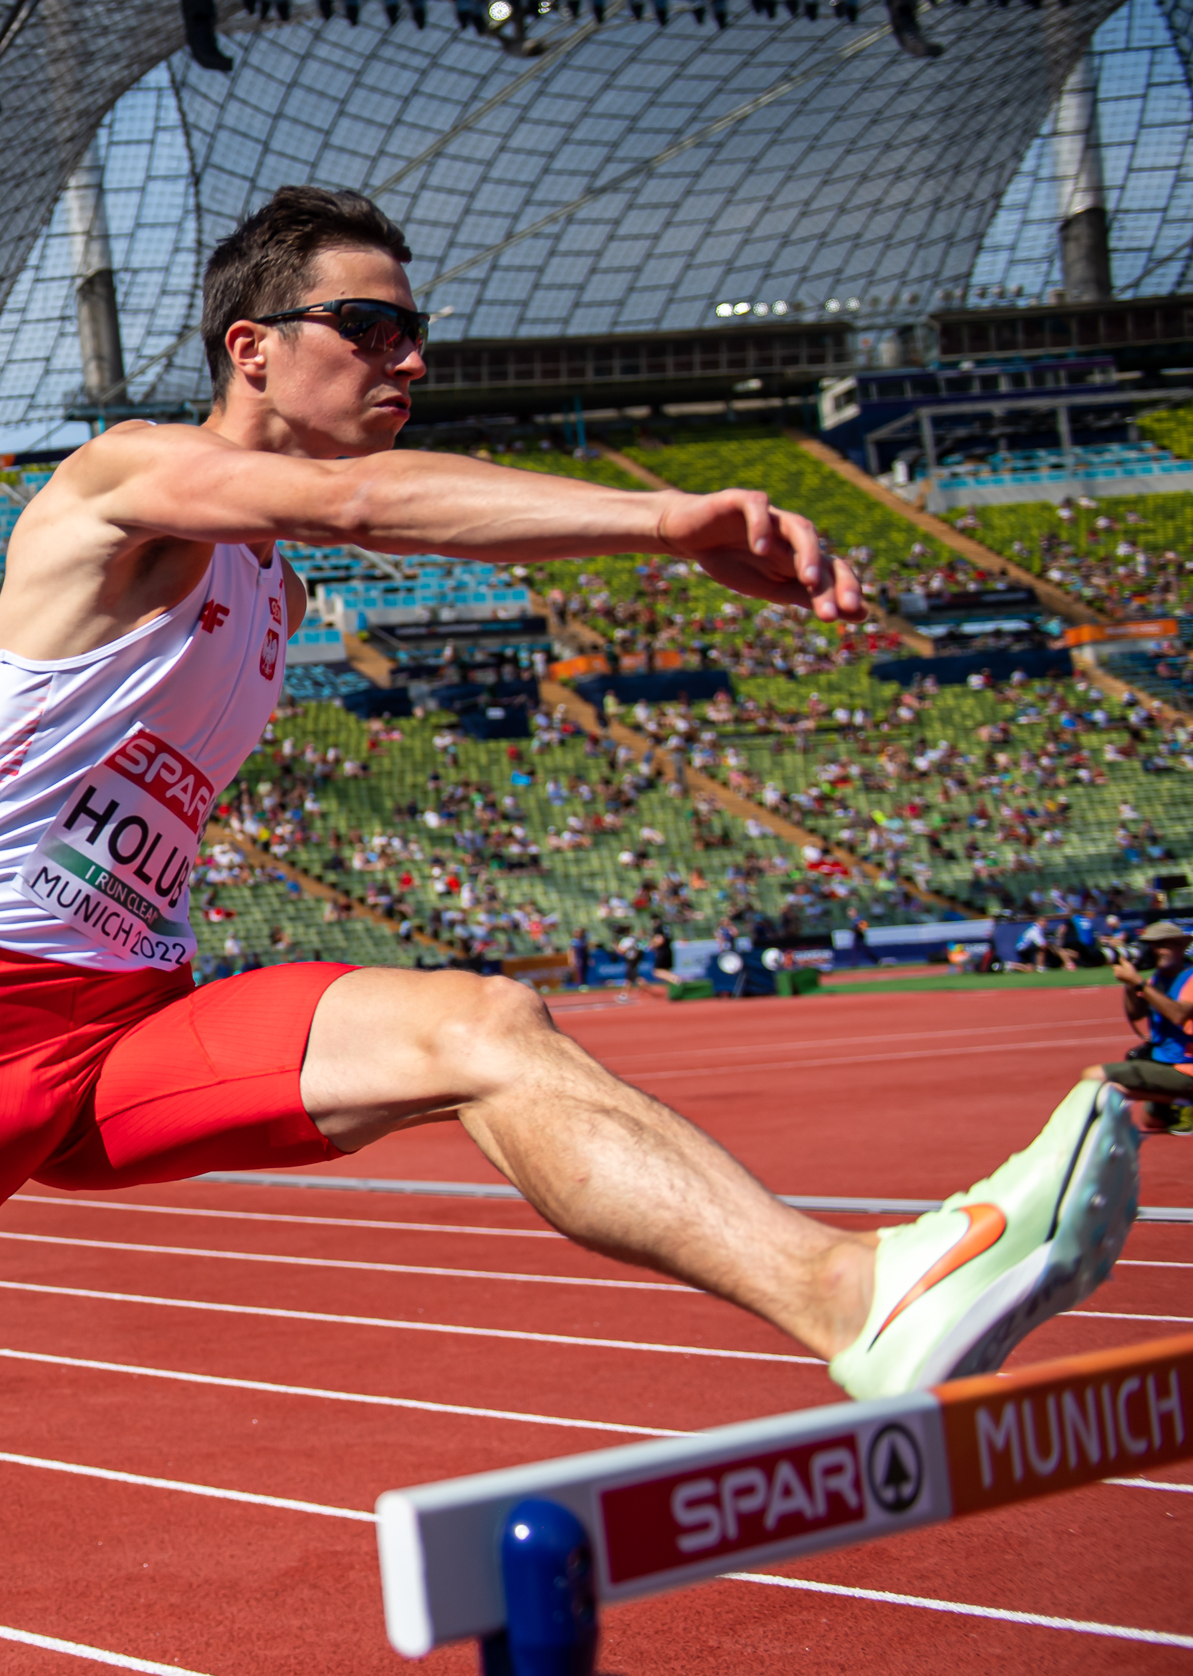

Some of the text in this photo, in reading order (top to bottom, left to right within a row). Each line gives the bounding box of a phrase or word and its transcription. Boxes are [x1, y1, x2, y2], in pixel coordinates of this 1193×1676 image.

[114, 738, 211, 826] SPAR
[62, 784, 190, 909] HOLUB
[95, 871, 128, 903] RUN
[29, 865, 187, 966] MUNICH 2022
[973, 1367, 1187, 1490] MUNICH
[669, 1446, 861, 1555] SPAR
